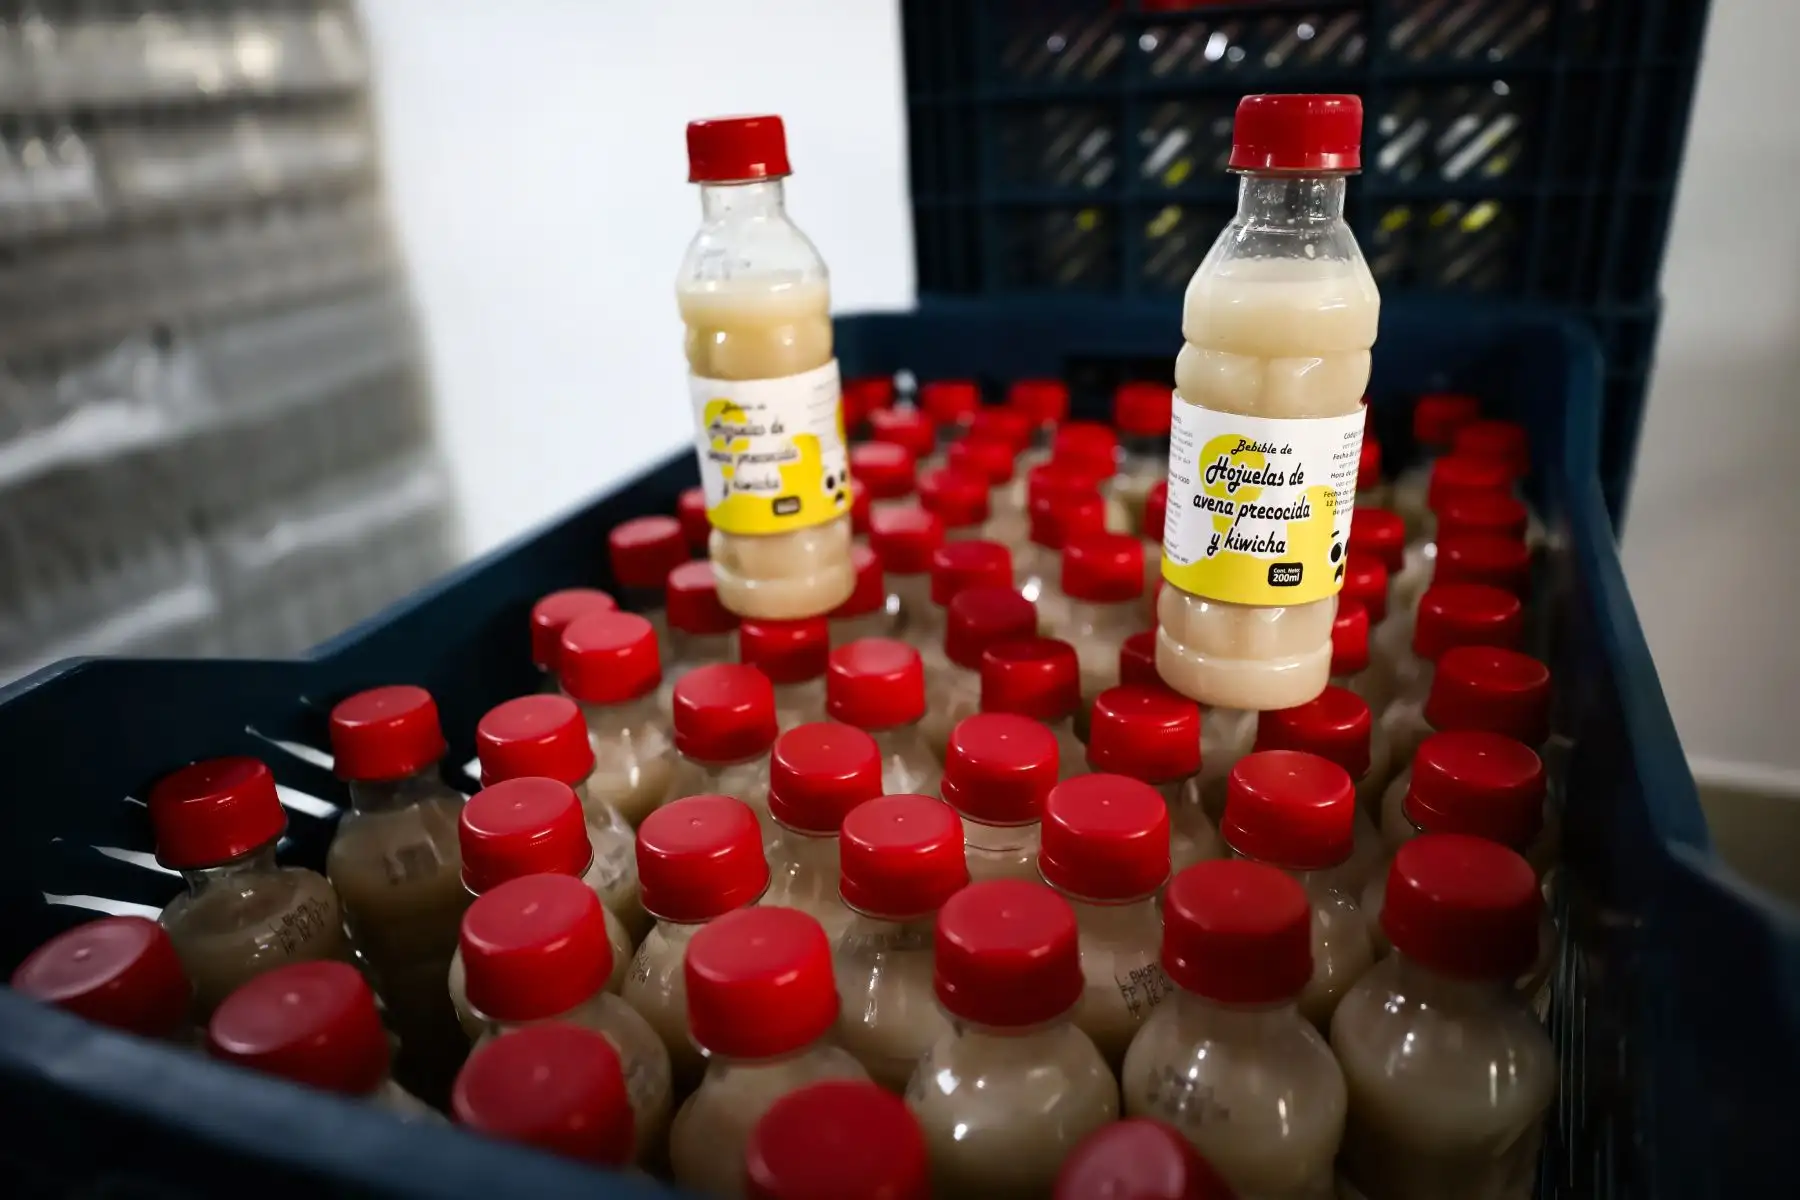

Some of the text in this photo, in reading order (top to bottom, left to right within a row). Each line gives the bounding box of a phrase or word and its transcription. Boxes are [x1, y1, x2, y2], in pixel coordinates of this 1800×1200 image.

[1230, 439, 1293, 455] Bebible de
[1205, 455, 1285, 494] Hojuelas
[1288, 462, 1304, 486] de
[1192, 494, 1234, 516] avena
[1234, 495, 1310, 527] precocida
[1206, 532, 1221, 557] y
[1223, 526, 1286, 554] kiwicha
[1272, 572, 1301, 583] 200ml
